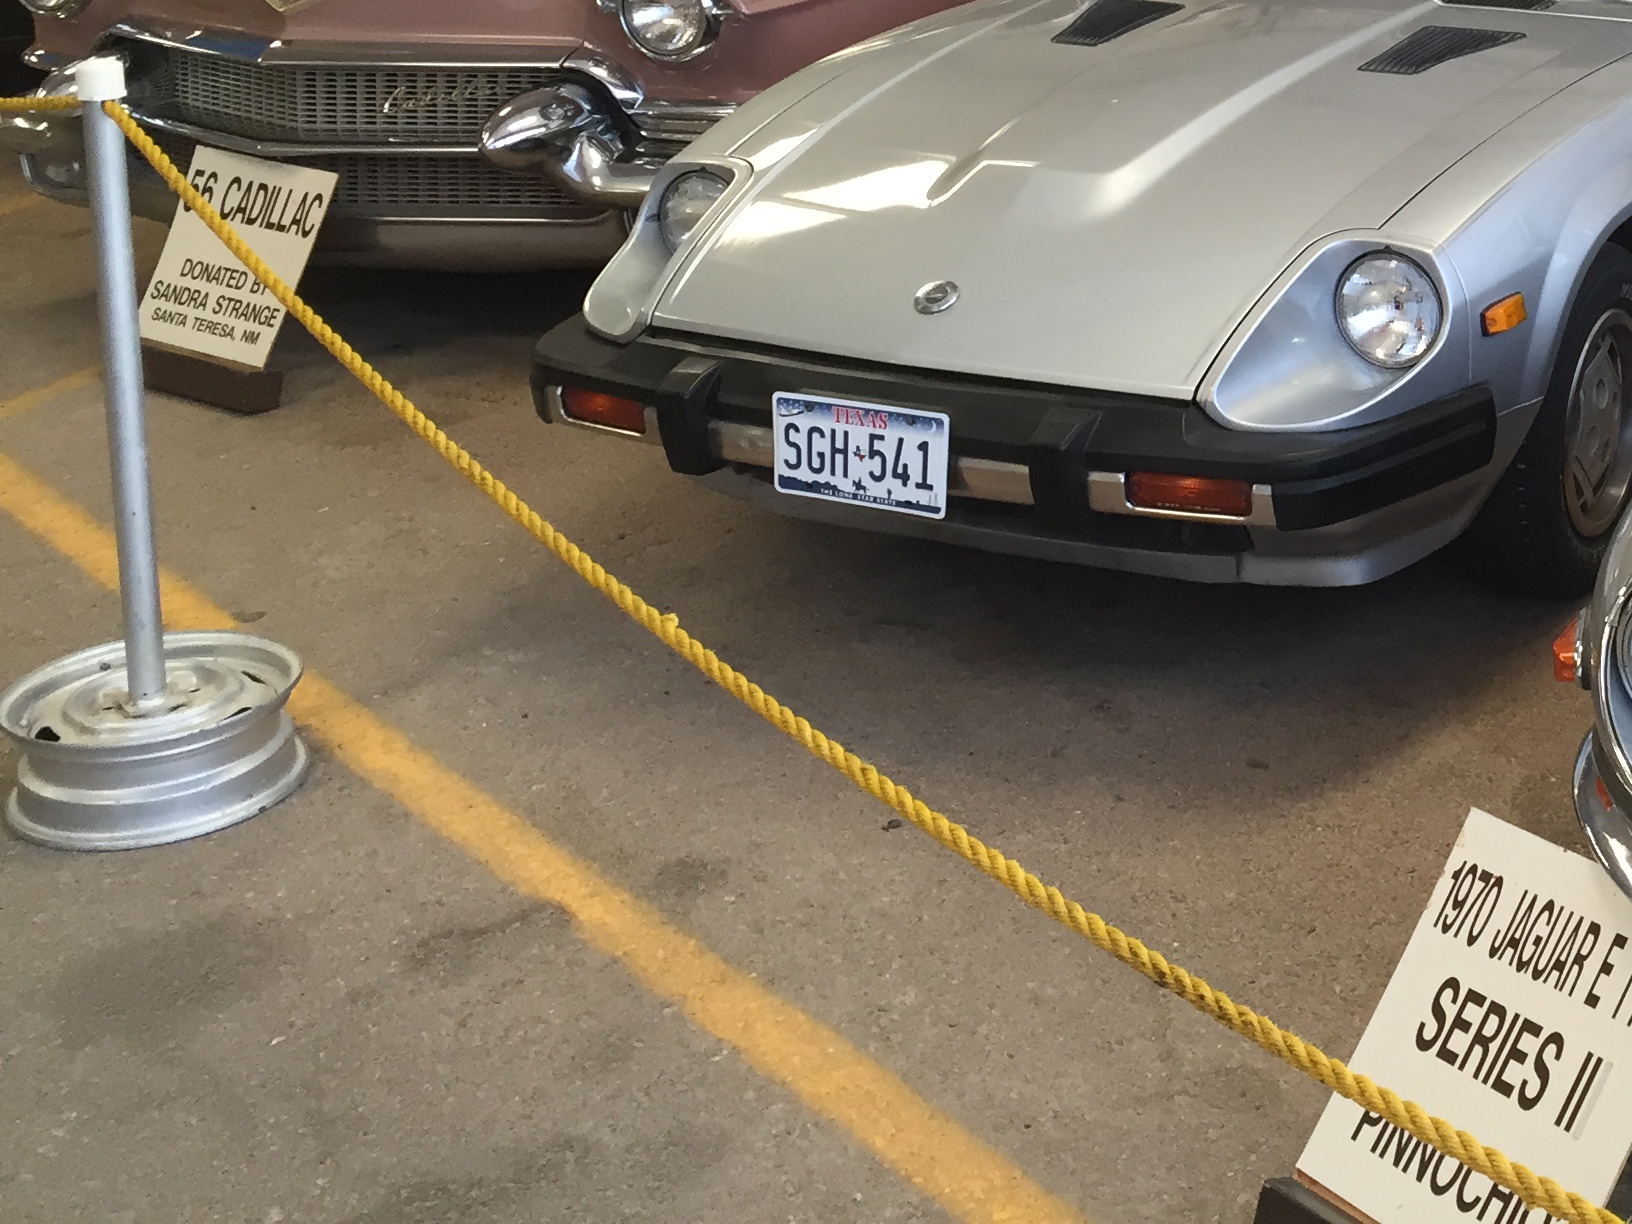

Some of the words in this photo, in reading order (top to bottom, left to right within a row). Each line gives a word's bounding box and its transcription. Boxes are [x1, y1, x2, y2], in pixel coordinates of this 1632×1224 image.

[220, 176, 324, 239] CADILLAC
[180, 257, 248, 291] DONATED
[150, 279, 209, 312] SANDRA
[212, 294, 280, 328] STRANGE
[151, 307, 188, 328] SANTA
[190, 316, 237, 342] TERESA,
[240, 328, 261, 346] NM
[832, 405, 889, 431] TEXAS
[783, 421, 850, 479] SGH
[867, 432, 934, 492] 541
[820, 488, 833, 496] THE
[834, 490, 853, 499] LONE
[857, 494, 874, 502] STAR
[876, 497, 897, 506] STATE
[1433, 859, 1505, 948] 1970
[1489, 889, 1602, 997] JAGUAR
[1583, 932, 1629, 1010] E
[1415, 975, 1566, 1112] SERIES
